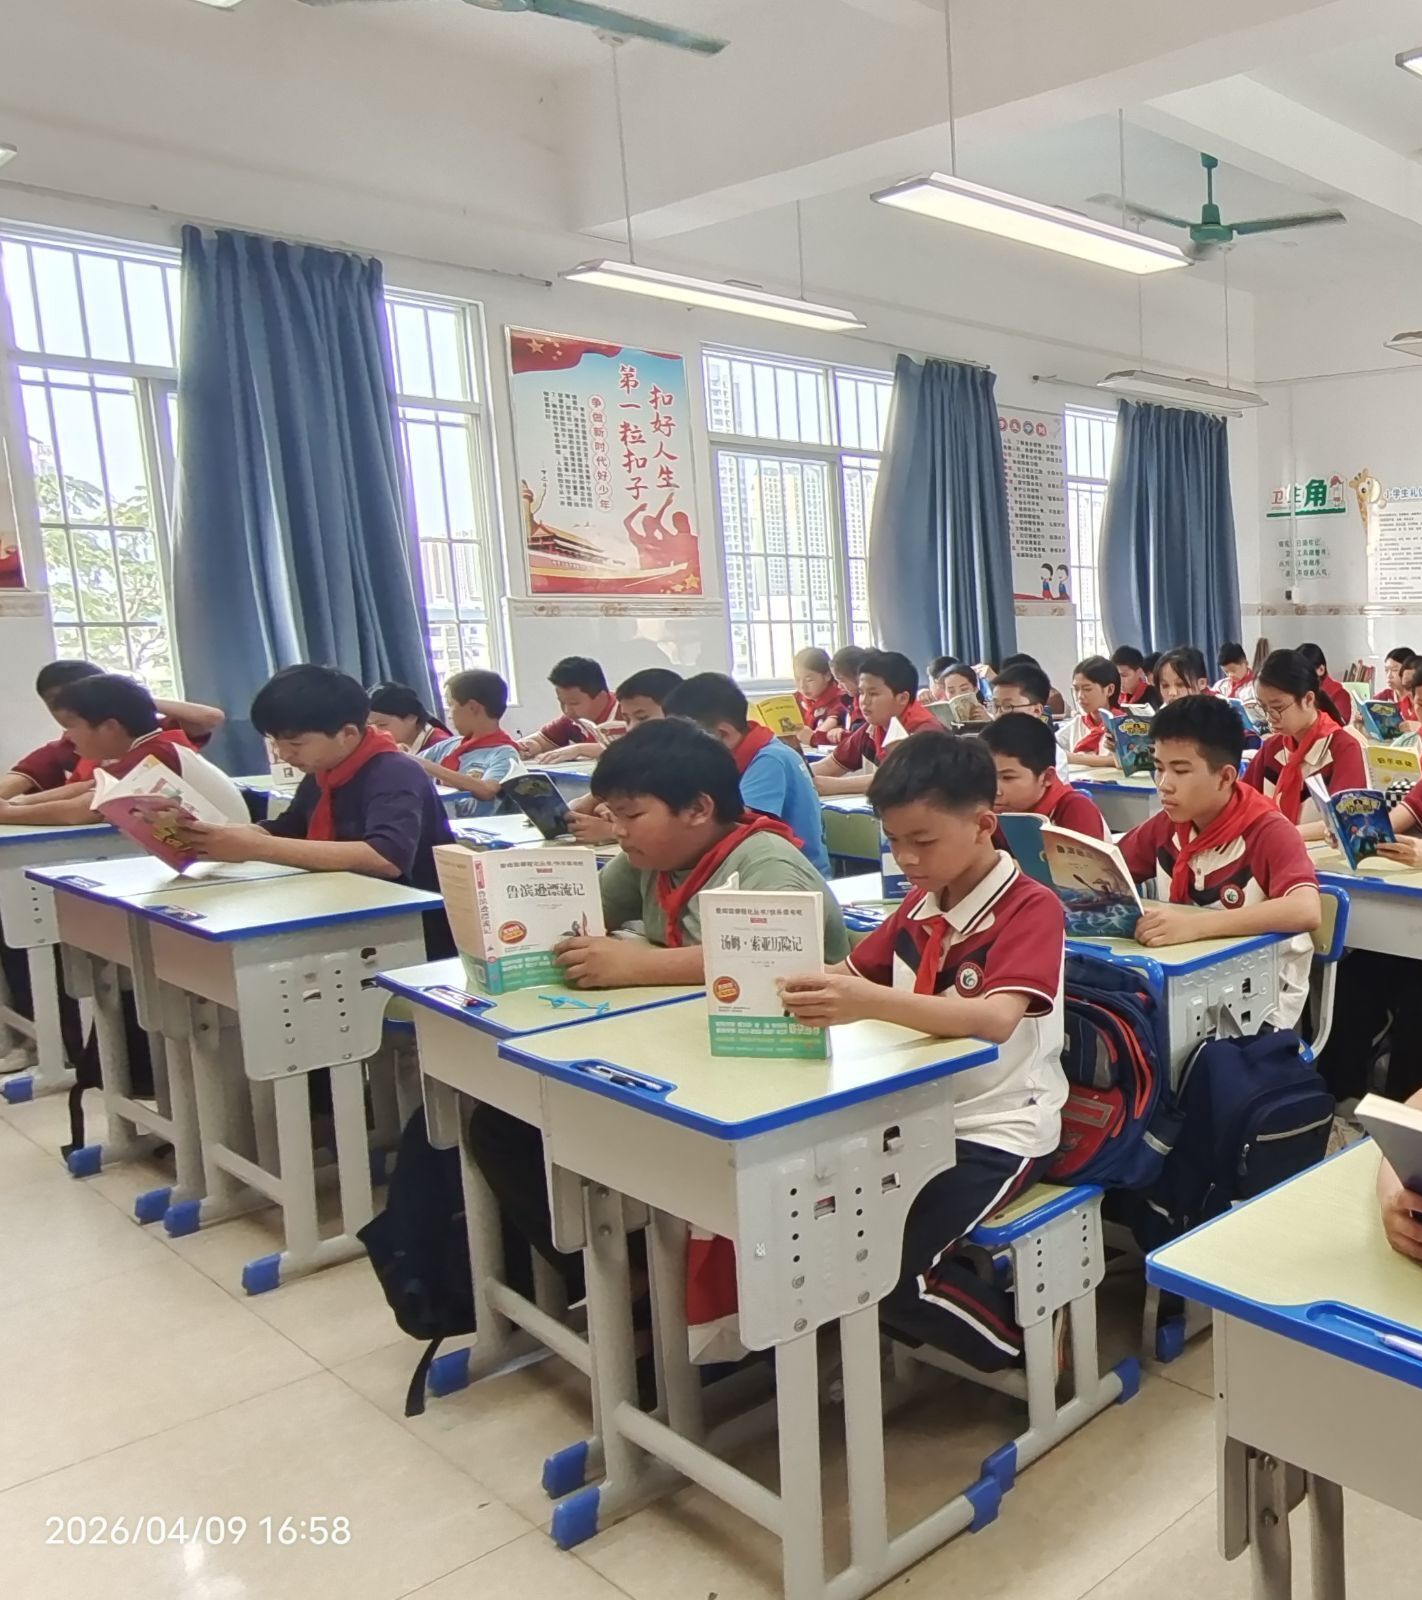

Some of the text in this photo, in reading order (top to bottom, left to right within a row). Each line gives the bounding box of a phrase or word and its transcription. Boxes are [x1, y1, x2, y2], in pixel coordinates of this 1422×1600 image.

[591, 397, 611, 509] 争做新时代好少年
[619, 364, 649, 500] 第一粒扣子
[650, 385, 680, 490] 扣好人生
[507, 883, 585, 899] 鲁滨逊漂流记
[721, 934, 803, 952] 汤姆·索亚历险记
